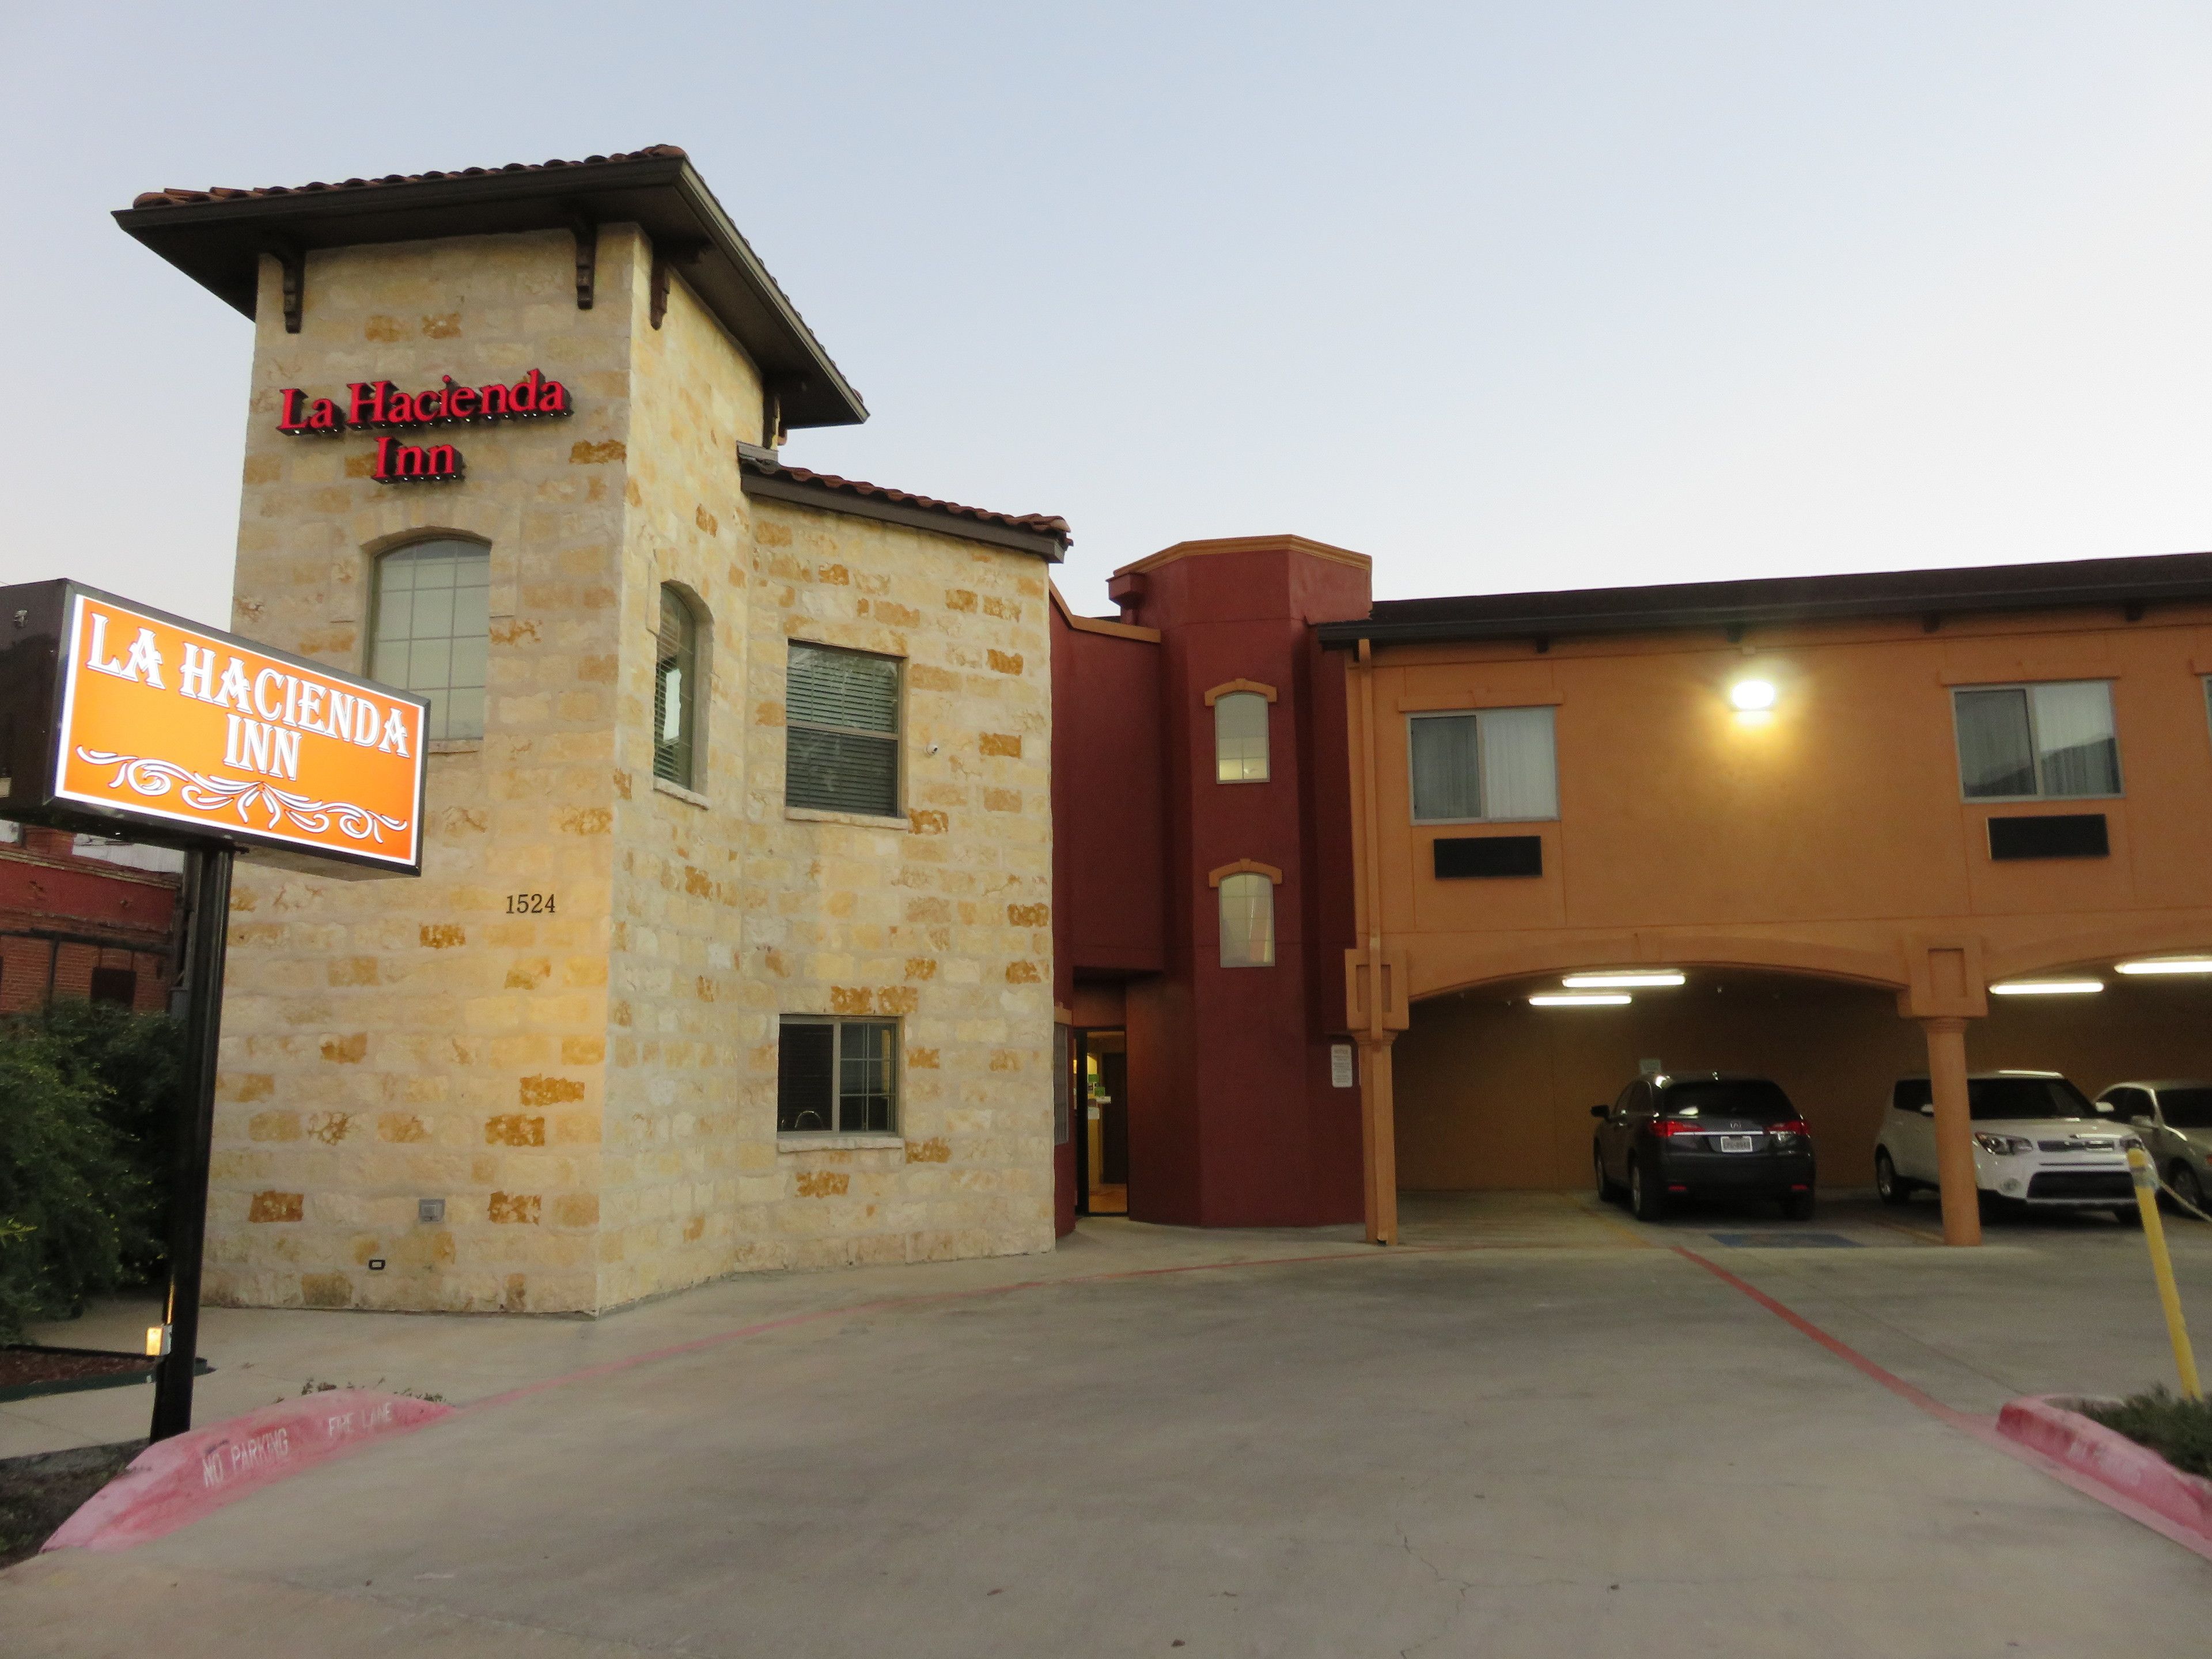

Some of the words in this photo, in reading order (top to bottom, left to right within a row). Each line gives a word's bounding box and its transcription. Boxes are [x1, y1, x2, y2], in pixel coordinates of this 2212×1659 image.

[277, 388, 336, 431] La
[346, 368, 567, 424] Hacienda
[374, 436, 455, 479] Inn
[86, 612, 166, 690] LA
[179, 641, 411, 759] HACIENDA
[223, 713, 302, 782] INN
[506, 893, 555, 914] 1524
[202, 1453, 224, 1487] NO
[231, 1427, 289, 1471] PARKING
